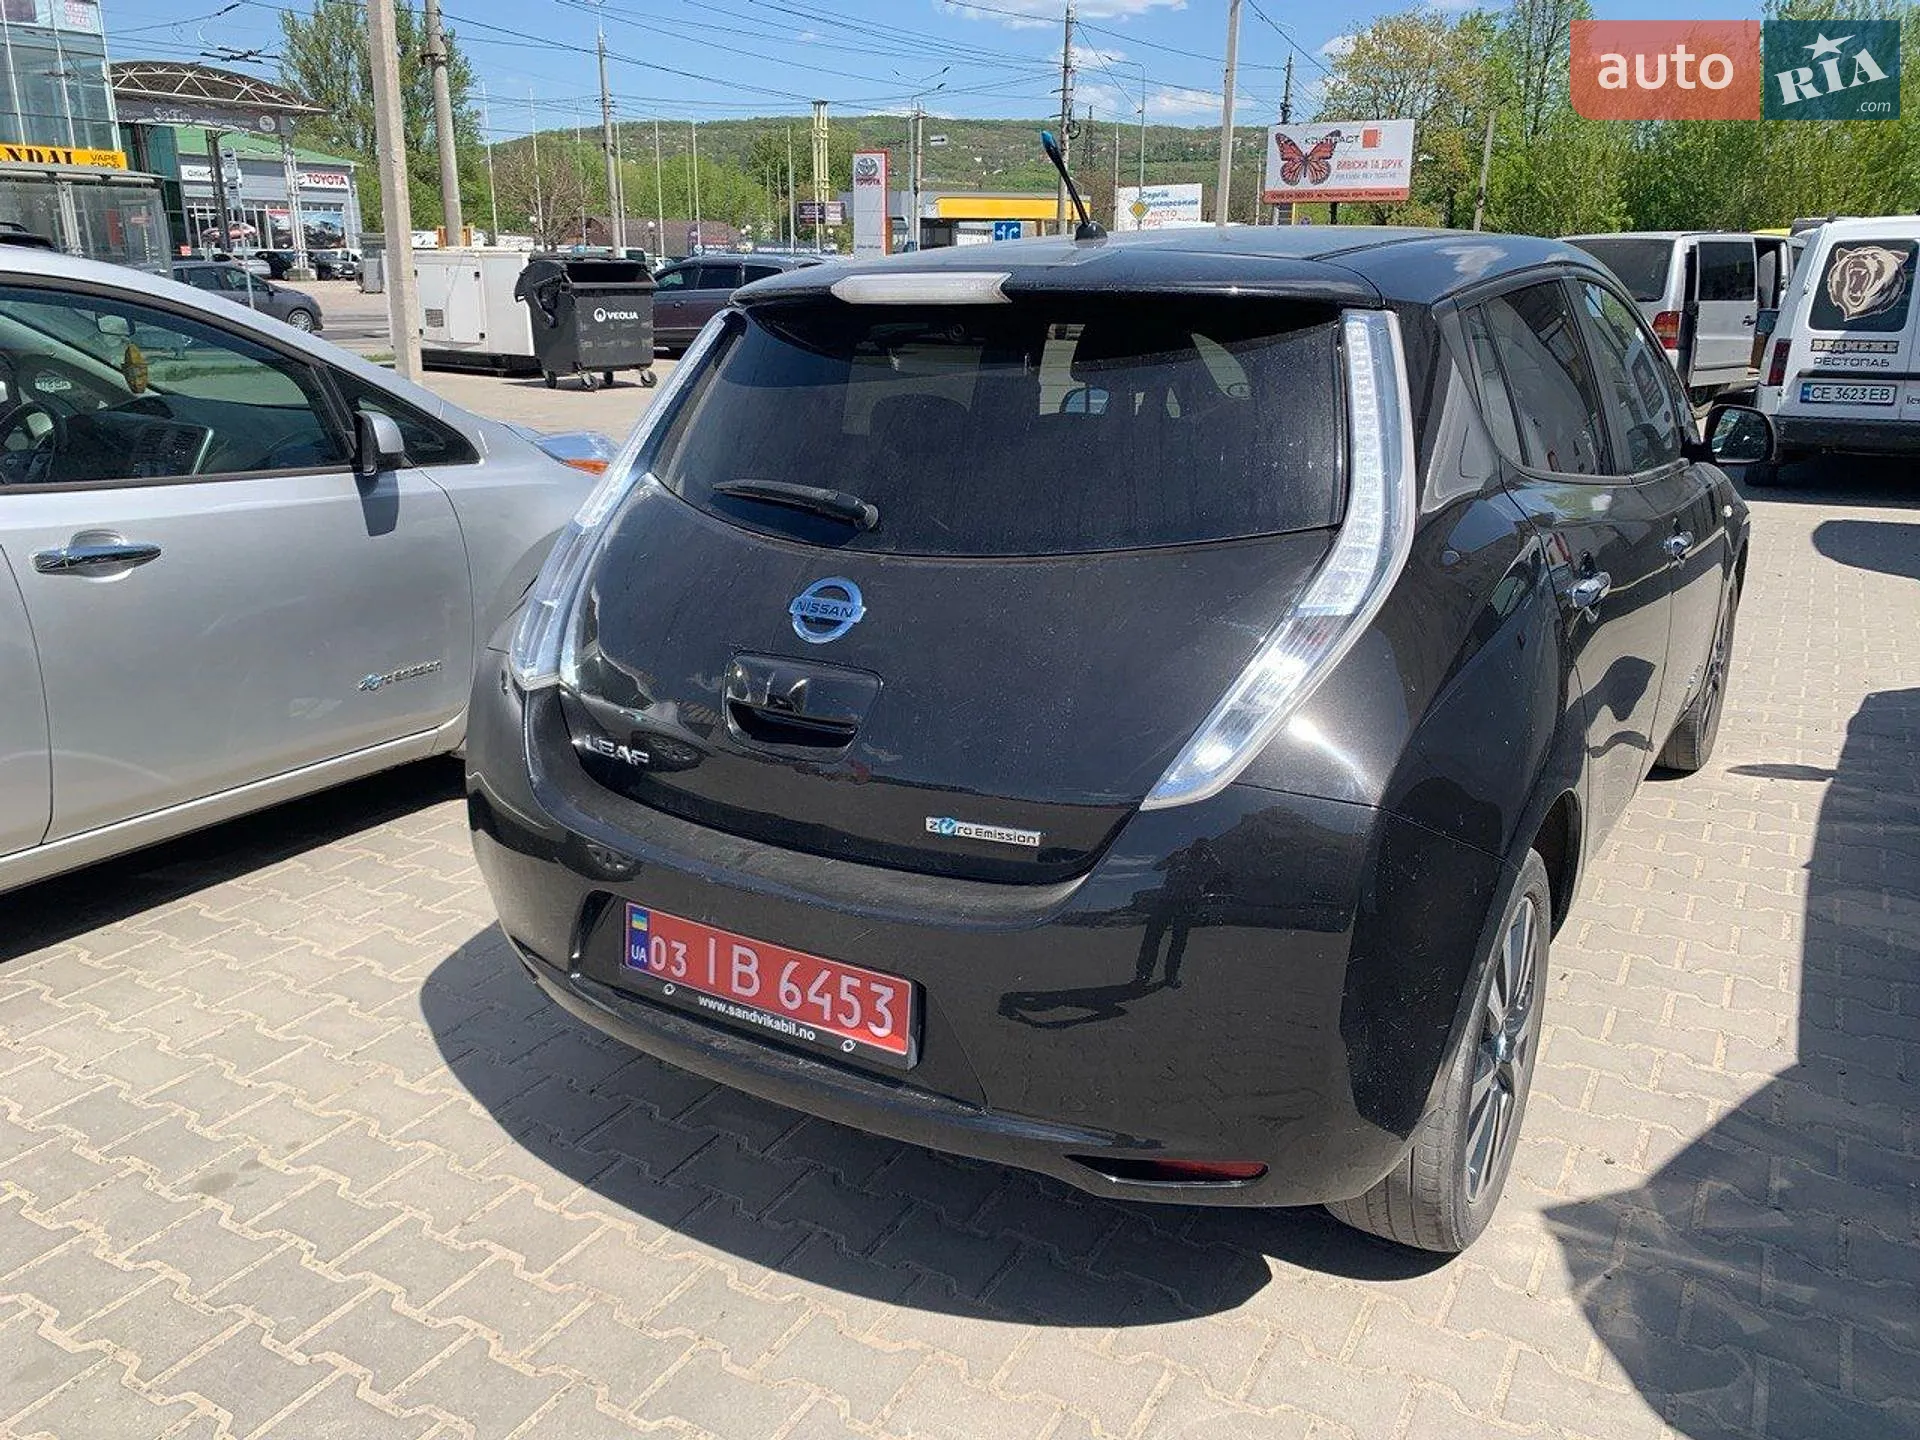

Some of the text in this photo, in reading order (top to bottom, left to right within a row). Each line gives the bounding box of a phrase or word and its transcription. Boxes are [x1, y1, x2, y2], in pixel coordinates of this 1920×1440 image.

[90, 154, 118, 162] VAPE
[306, 173, 347, 186] TOYOTA
[607, 311, 639, 320] VEOLIA
[1813, 357, 1891, 368] РЕСТОПАБ
[1811, 387, 1832, 400] CE
[1834, 387, 1867, 401] 3623
[794, 600, 854, 618] NISSAN
[585, 735, 649, 765] LEAF
[631, 943, 648, 963] UA
[650, 935, 687, 978] 03
[779, 961, 894, 1038] 6453
[698, 995, 816, 1041] www.sandvikabil.no
